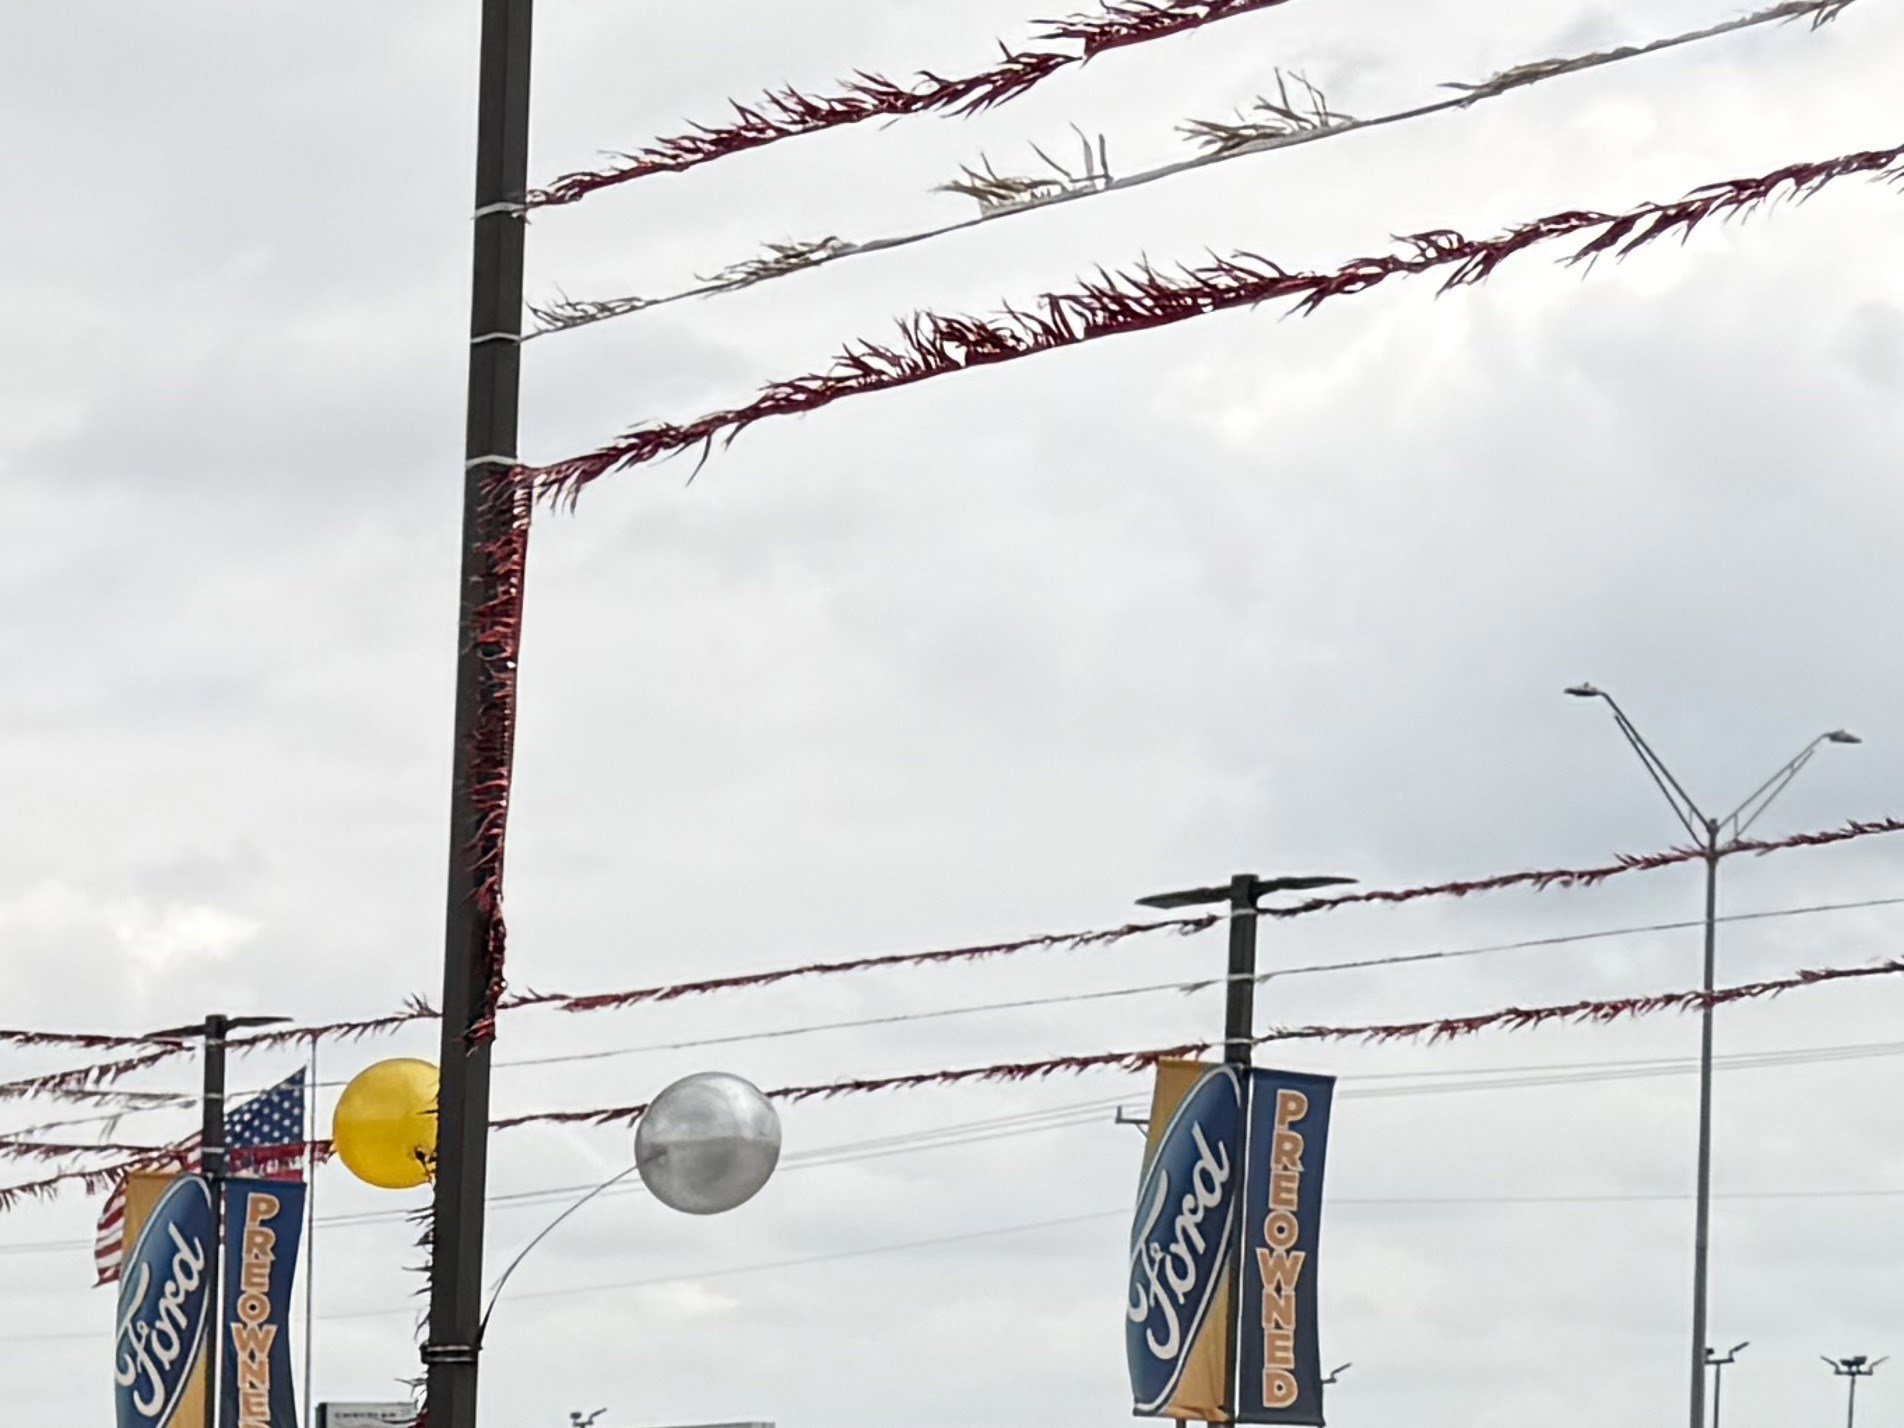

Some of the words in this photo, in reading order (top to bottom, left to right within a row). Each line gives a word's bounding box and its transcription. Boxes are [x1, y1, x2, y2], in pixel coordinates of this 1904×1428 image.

[115, 1221, 204, 1417] Ford
[1127, 1121, 1231, 1360] Ford
[1255, 1088, 1308, 1408] PREOWNED
